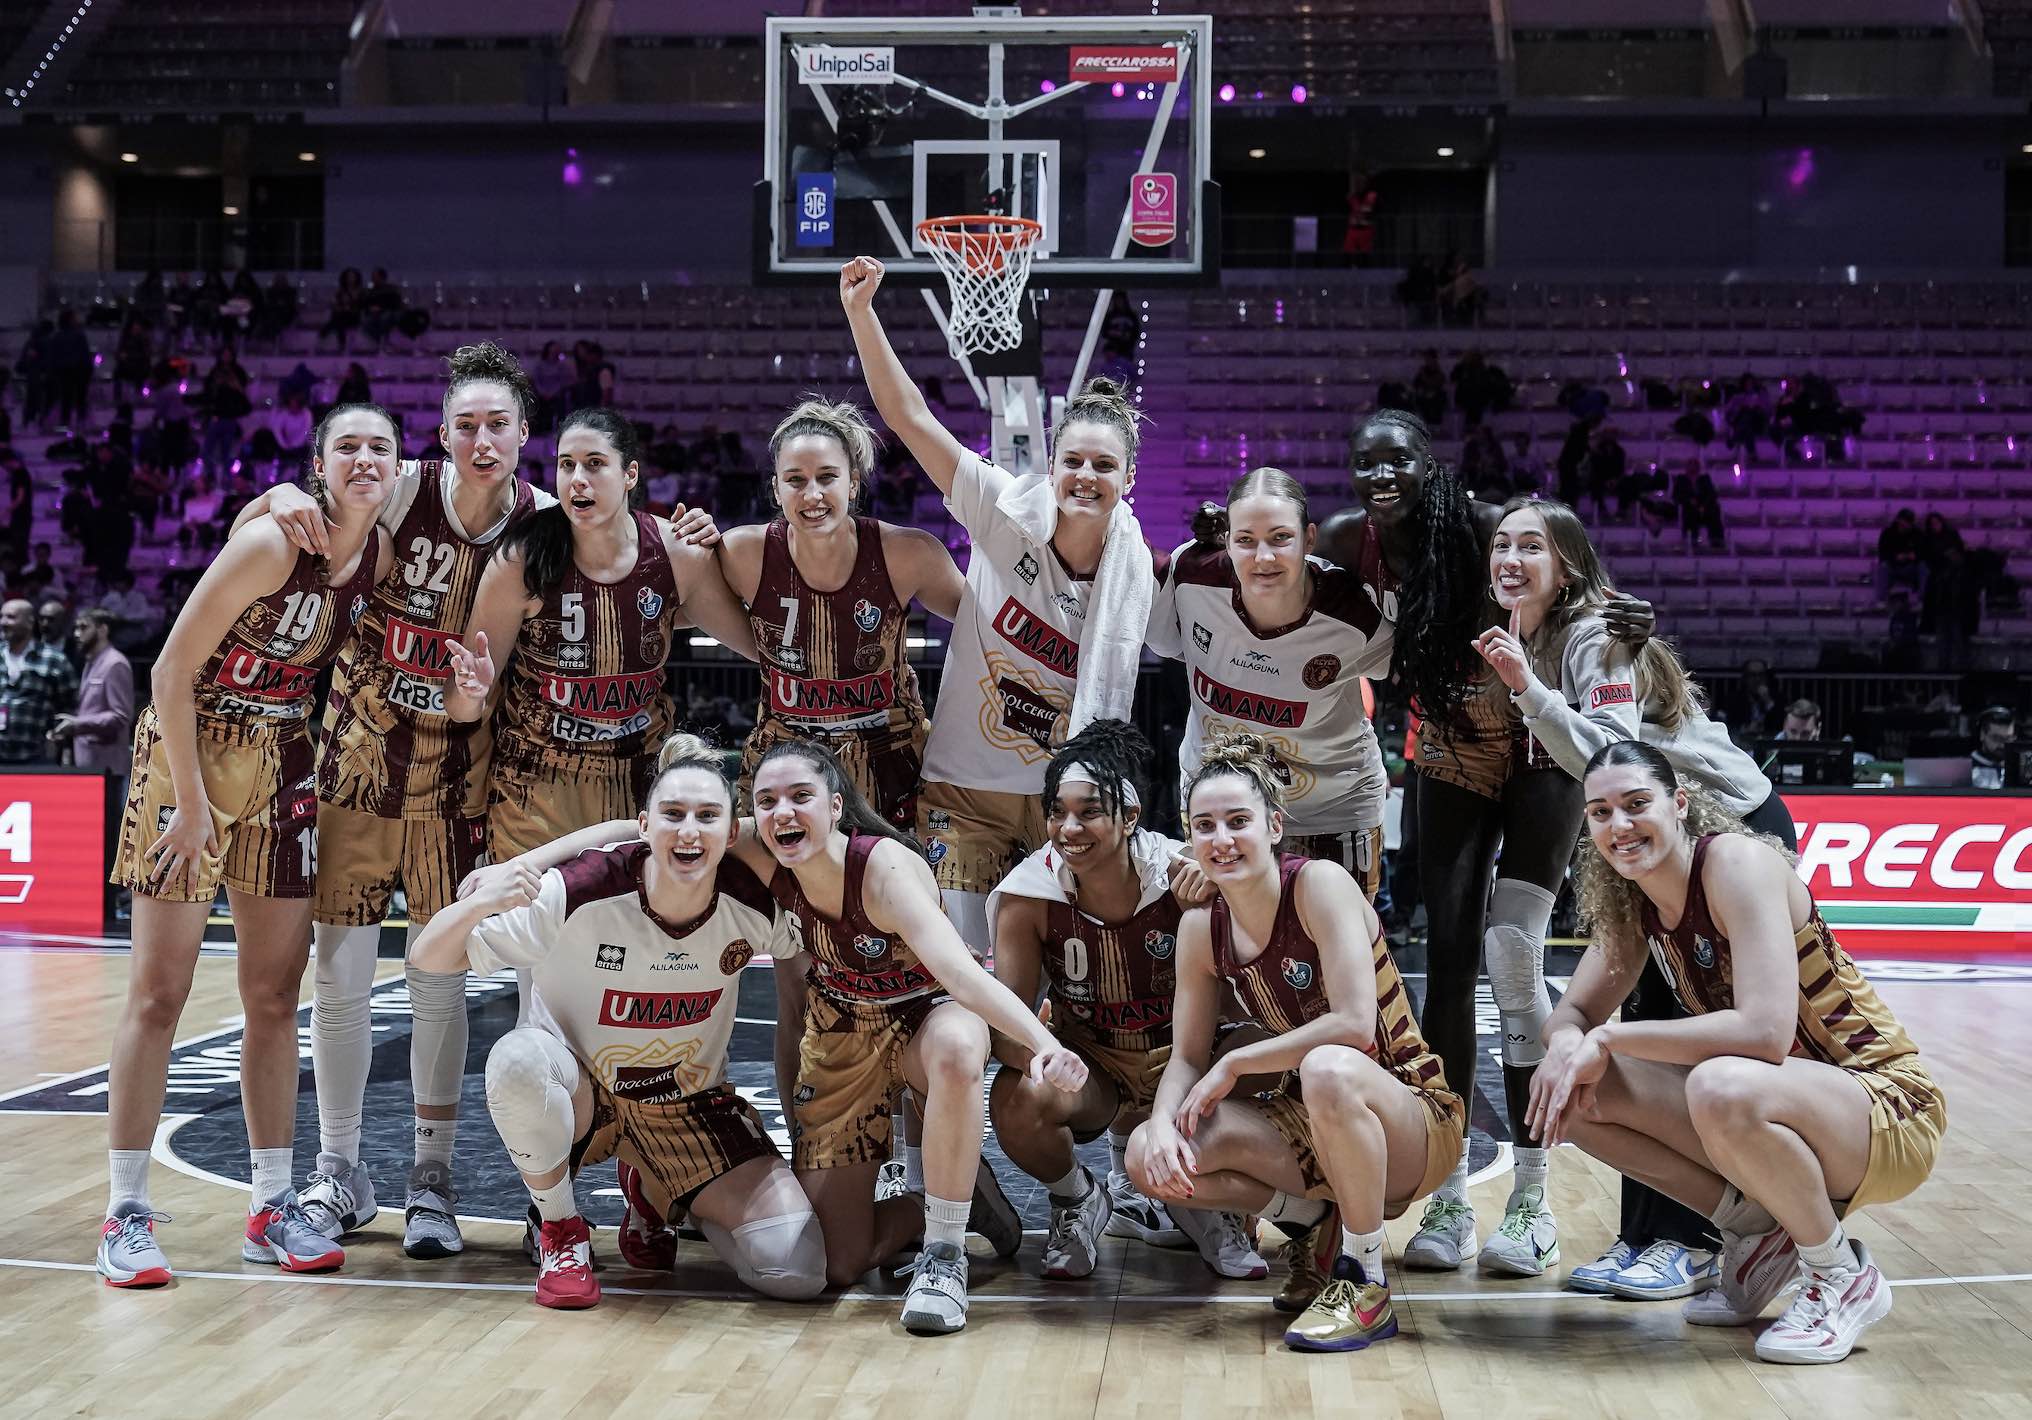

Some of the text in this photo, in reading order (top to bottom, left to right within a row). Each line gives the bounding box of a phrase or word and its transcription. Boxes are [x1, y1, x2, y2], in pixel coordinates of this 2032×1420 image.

[809, 53, 890, 78] UnipolSai
[1074, 56, 1176, 69] FRECCIAROSSA
[800, 220, 830, 233] FIP
[404, 536, 456, 593] 32
[274, 591, 322, 640] 19
[407, 605, 432, 618] errea
[561, 592, 586, 642] 5
[780, 598, 799, 647] 7
[559, 659, 584, 668] errea
[1229, 657, 1280, 676] ALILAGUNA
[777, 676, 887, 709] UMANA
[1197, 675, 1295, 726] UMANA
[1591, 686, 1632, 704] UMANA
[597, 959, 622, 971] errea
[649, 962, 700, 972] ALILAGUNA
[1064, 937, 1089, 982] 0
[609, 995, 711, 1025] UMANA
